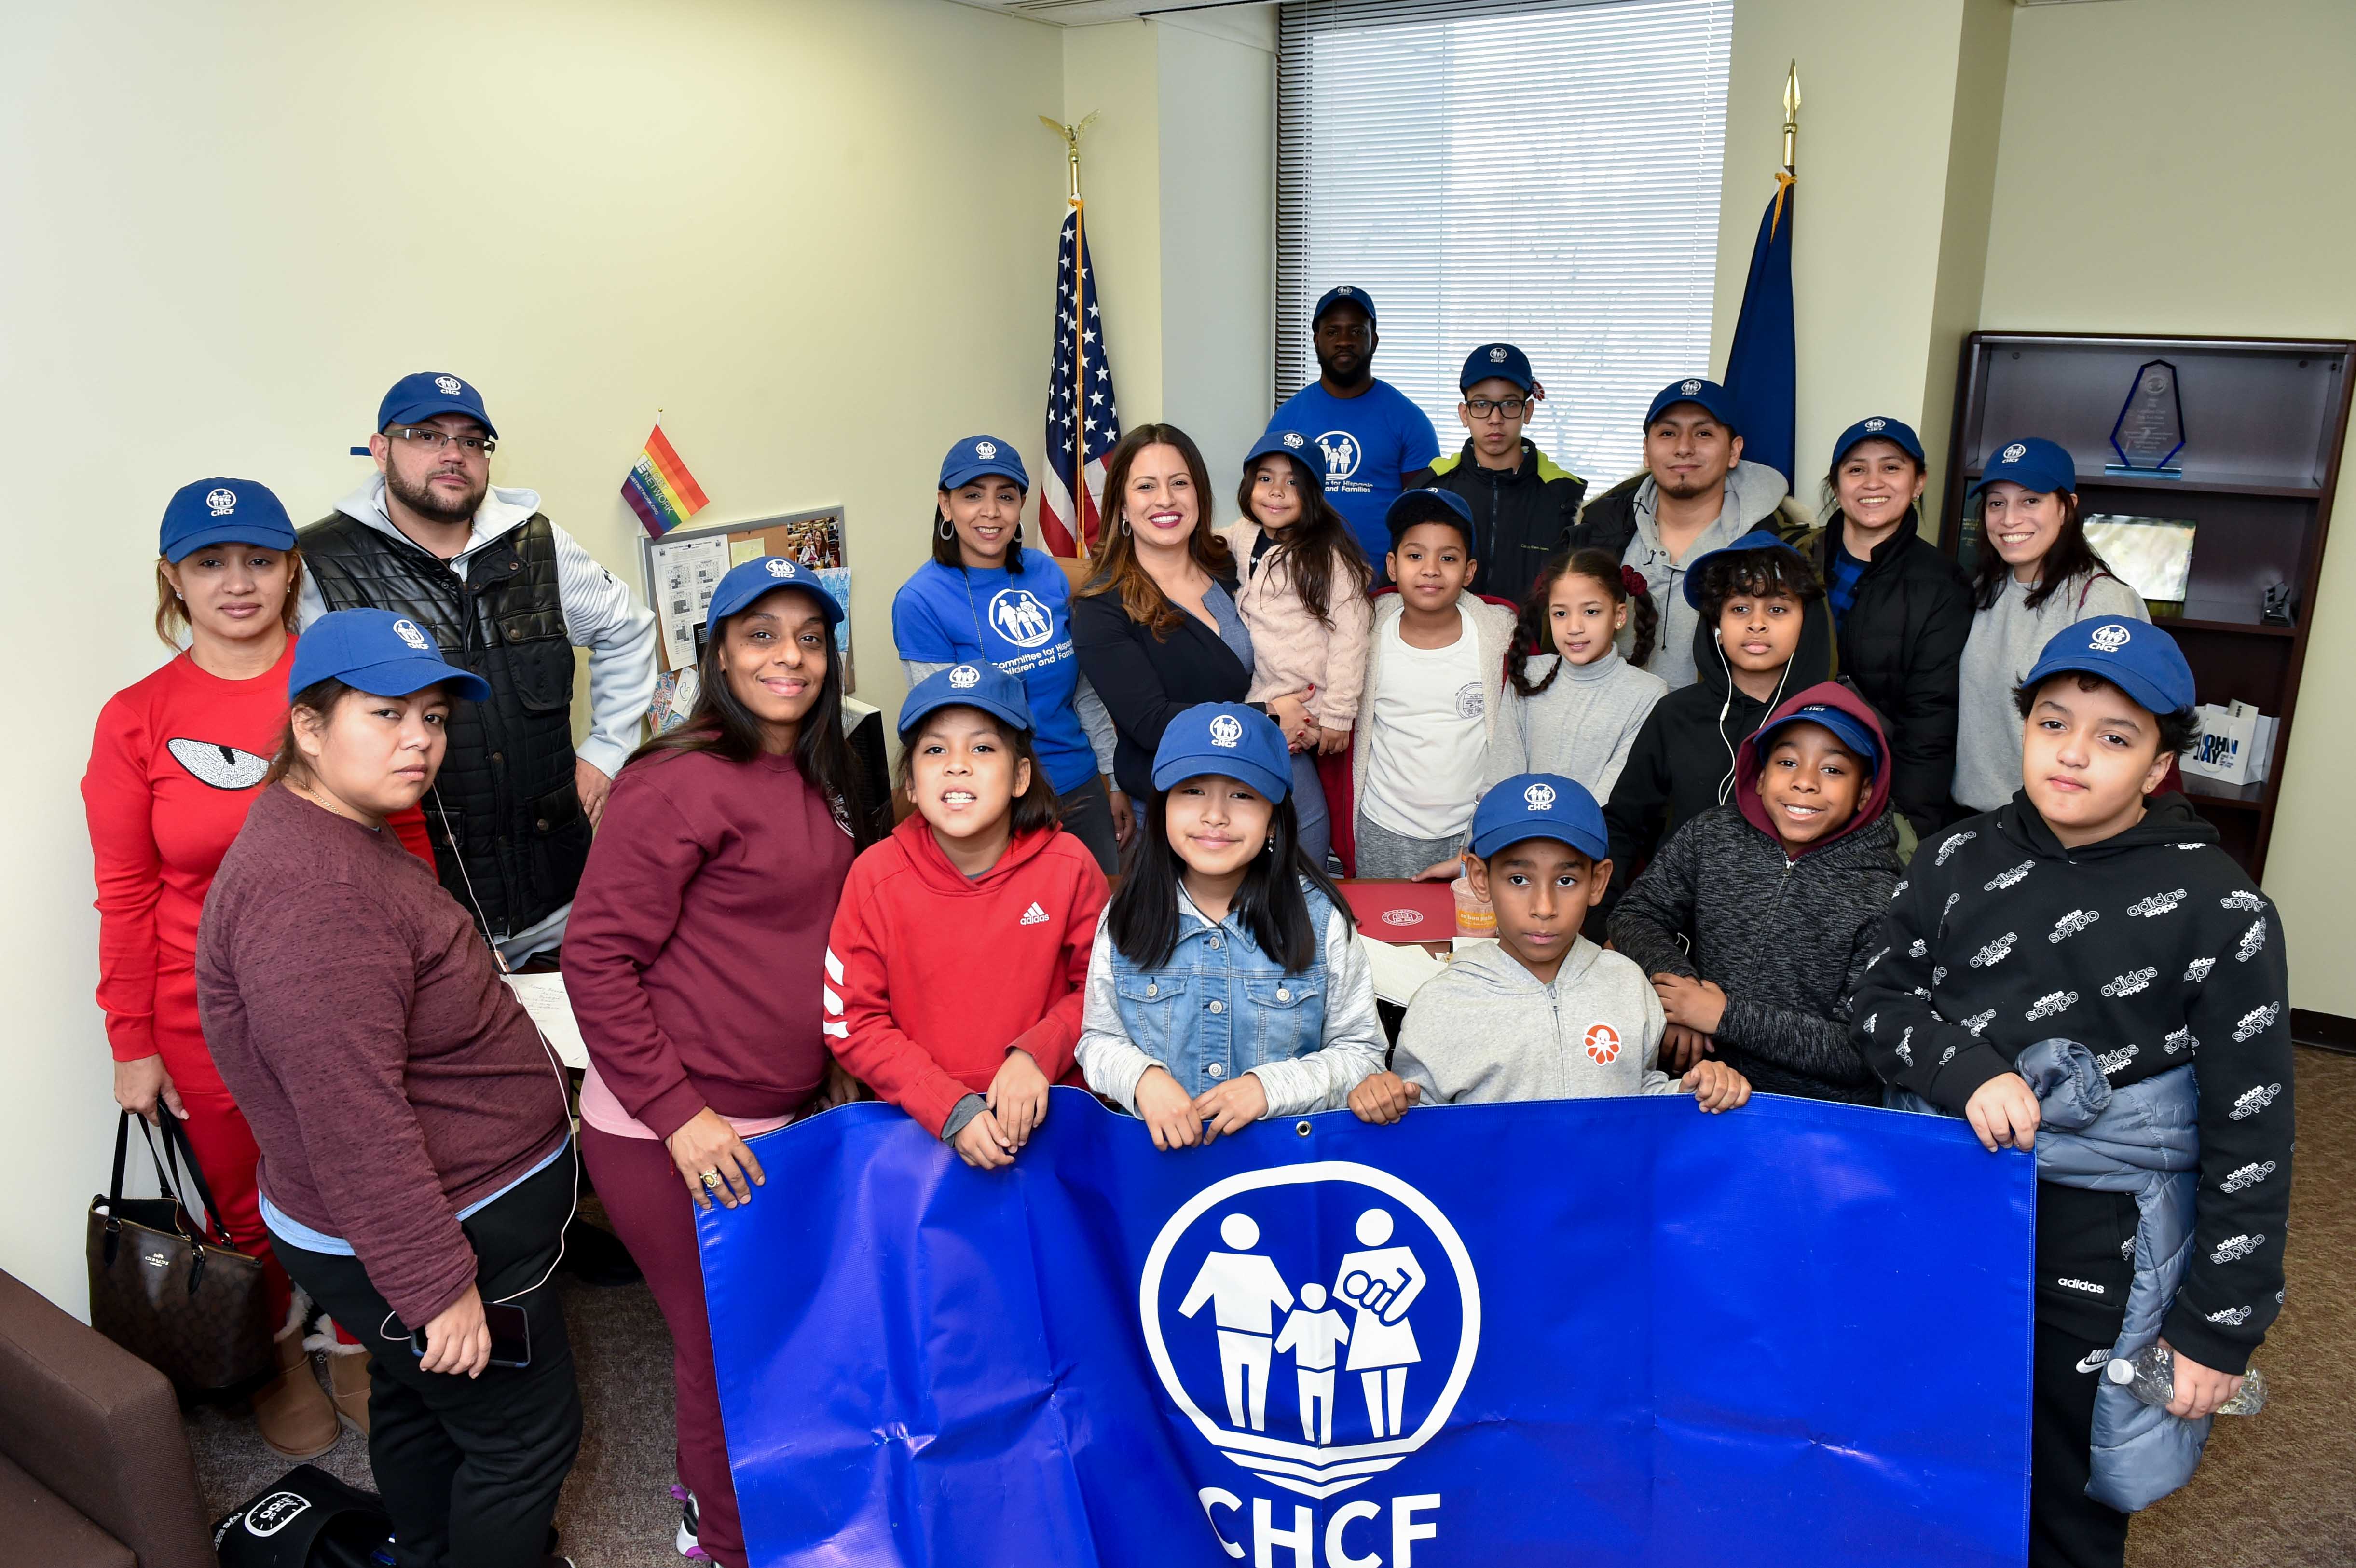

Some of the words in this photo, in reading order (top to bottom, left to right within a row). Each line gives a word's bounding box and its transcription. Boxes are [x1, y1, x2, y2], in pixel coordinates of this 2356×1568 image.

[649, 466, 668, 491] LGBT
[642, 472, 674, 515] NETWORK
[211, 508, 234, 517] CHCF
[1042, 647, 1055, 656] for
[1055, 639, 1073, 652] Hispan
[2088, 642, 2119, 653] CHCF
[1038, 655, 1056, 667] and
[1211, 738, 1237, 748] CHCF
[1935, 831, 1977, 866] adidas
[1984, 860, 2035, 891] adidas
[1999, 871, 2028, 889] adidas
[2127, 888, 2187, 916] adidas
[2144, 902, 2178, 917] adidas
[1020, 914, 1050, 926] adidas
[2049, 910, 2100, 944] adidas
[2055, 909, 2082, 929] adidas
[1970, 932, 2017, 968] adidas
[1985, 946, 2011, 967] adidas
[2101, 966, 2158, 997] adidas
[2117, 981, 2149, 997] adidas
[2026, 991, 2079, 1021] adidas
[2034, 990, 2064, 1008] adidas
[2232, 1001, 2280, 1042] adidas
[2237, 1005, 2267, 1027] adidas
[2096, 1044, 2139, 1068] didas
[2229, 1083, 2281, 1120] adidas
[2234, 1085, 2264, 1107] adidas
[2220, 1160, 2276, 1193] adidas
[2227, 1162, 2259, 1180] adidas
[2210, 1234, 2265, 1264] adidas
[2217, 1234, 2248, 1251] adidas
[145, 1256, 169, 1266] COACH
[2058, 1278, 2105, 1294] adidas
[1198, 1486, 1440, 1568] CHCF
